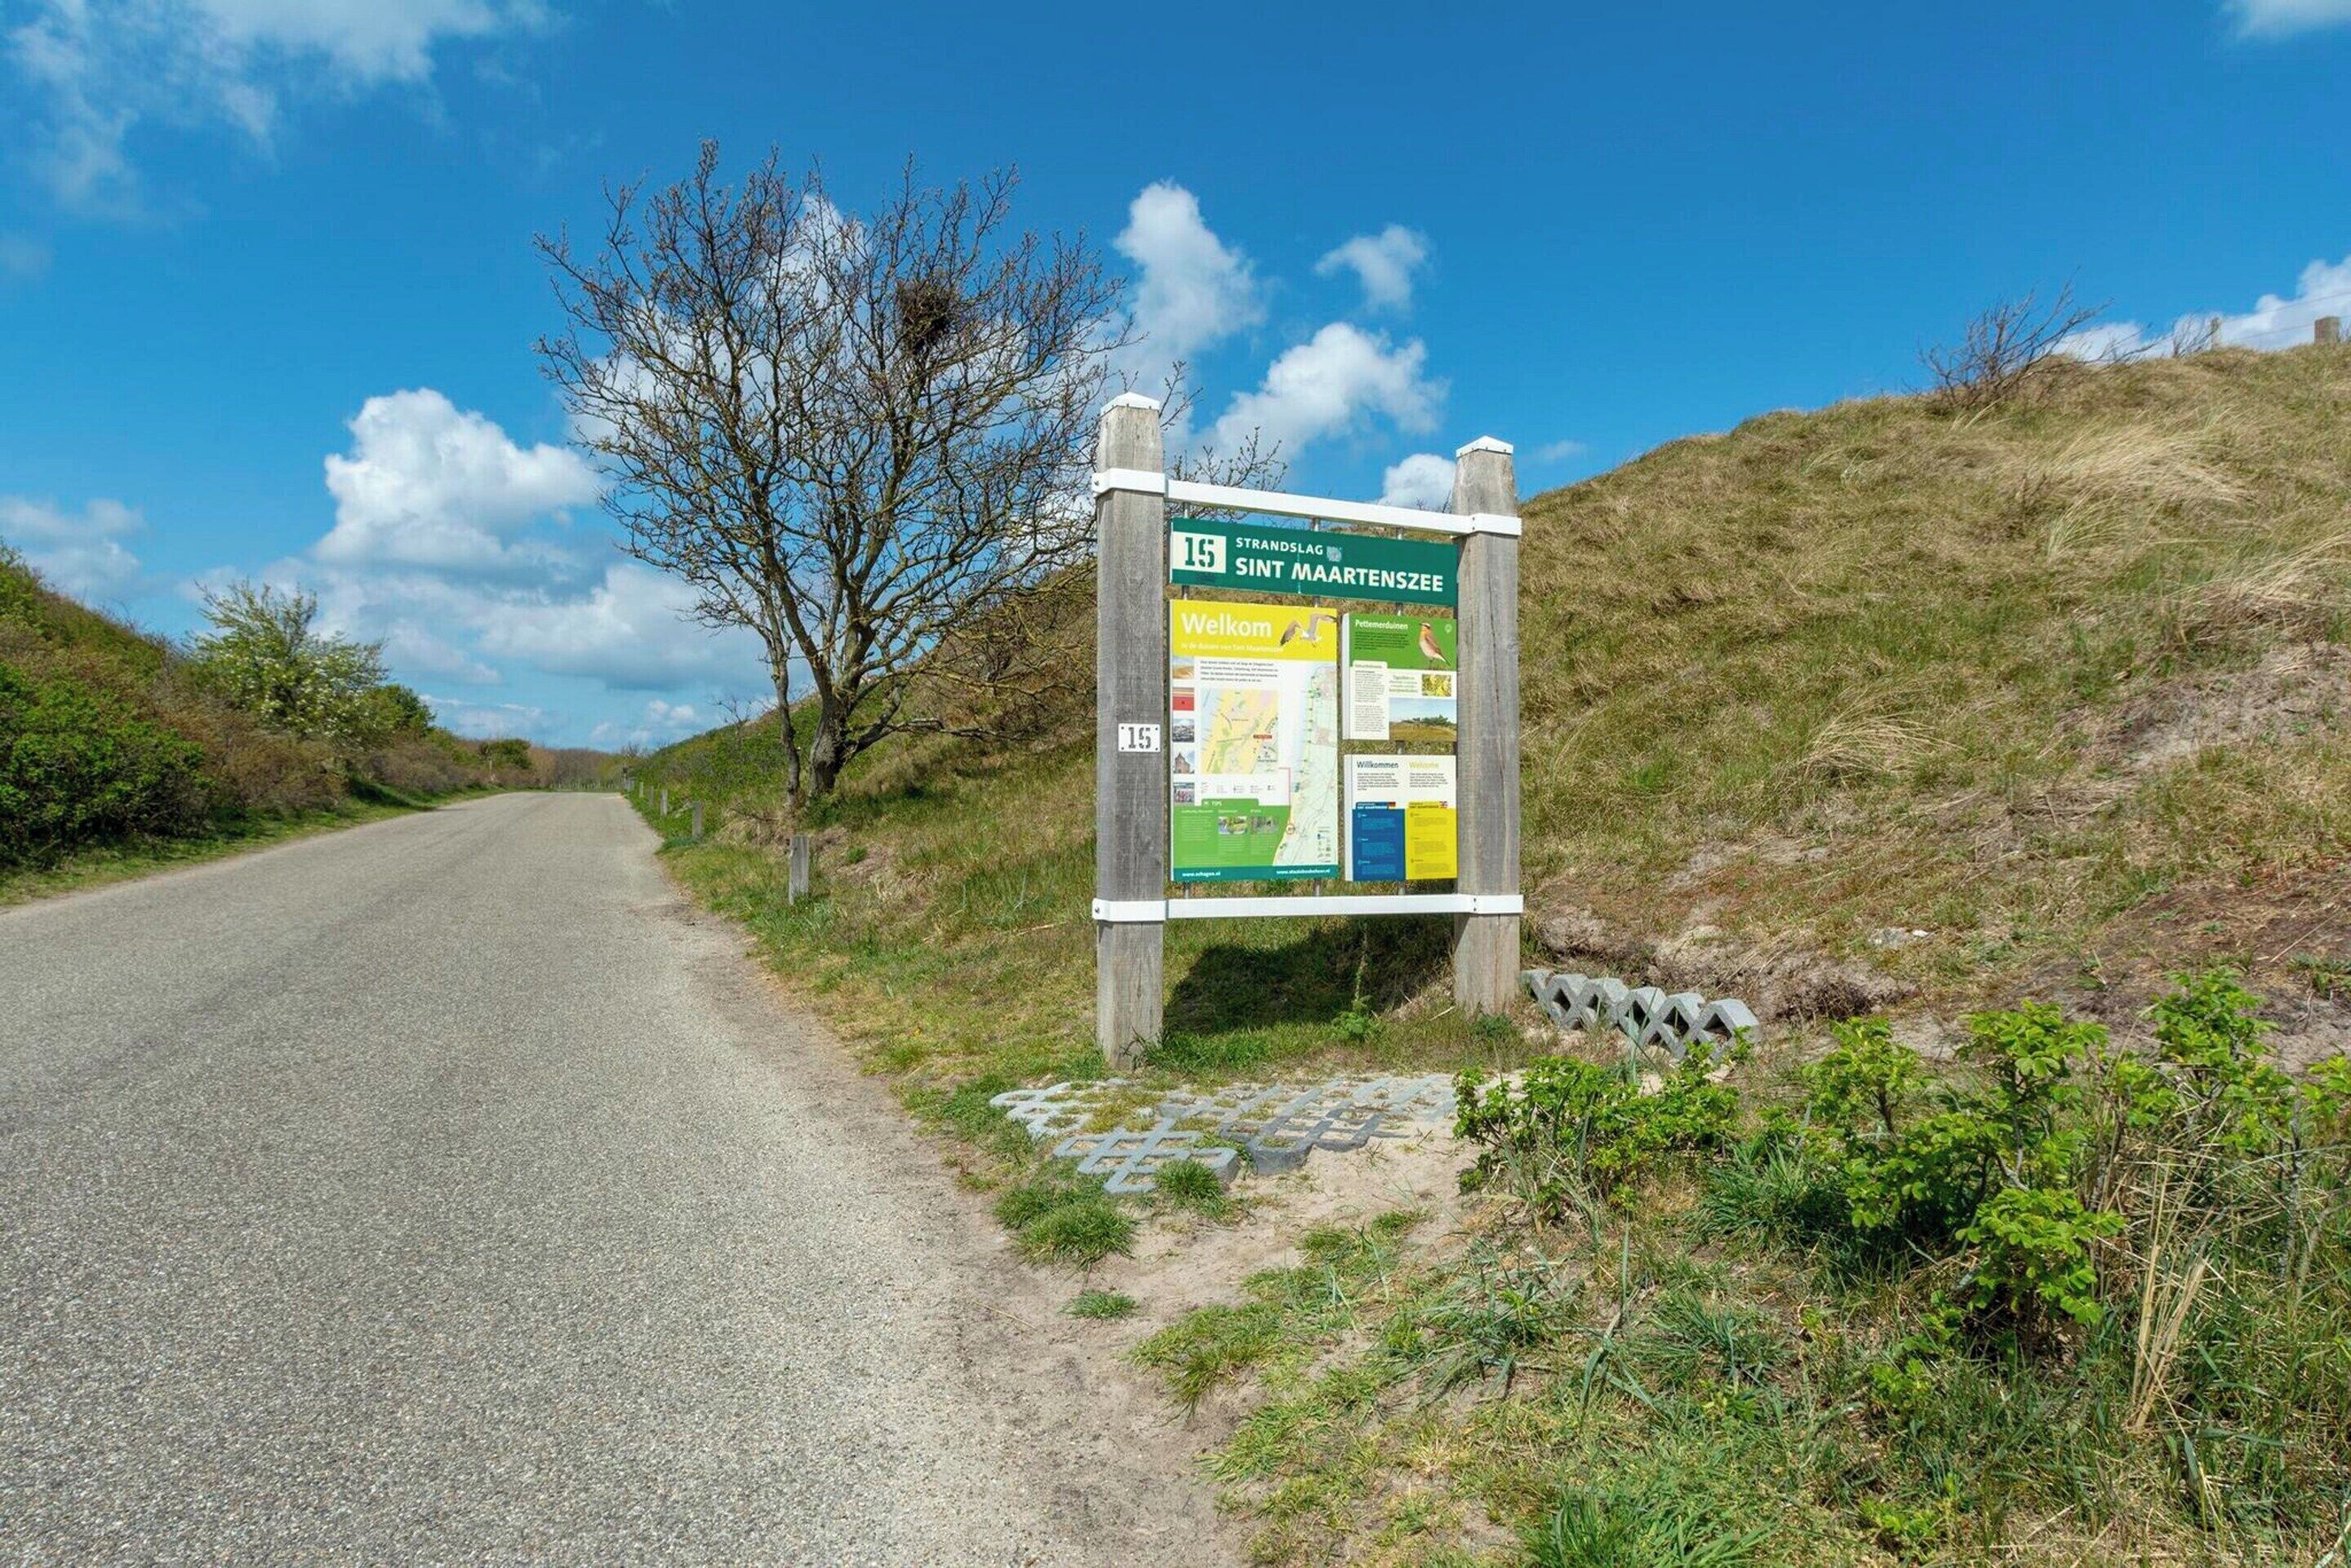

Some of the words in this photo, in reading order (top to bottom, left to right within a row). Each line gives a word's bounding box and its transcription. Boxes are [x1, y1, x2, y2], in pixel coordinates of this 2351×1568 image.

[1184, 536, 1215, 568] 15
[1235, 536, 1323, 555] STRANDSLAG
[1235, 557, 1285, 579] SINT
[1291, 562, 1444, 593] MAARTENSZEE
[1180, 612, 1273, 637] Welkom
[1355, 619, 1408, 630] Pettemerduinen
[1128, 726, 1151, 748] 15
[1356, 760, 1399, 769] Willkommen
